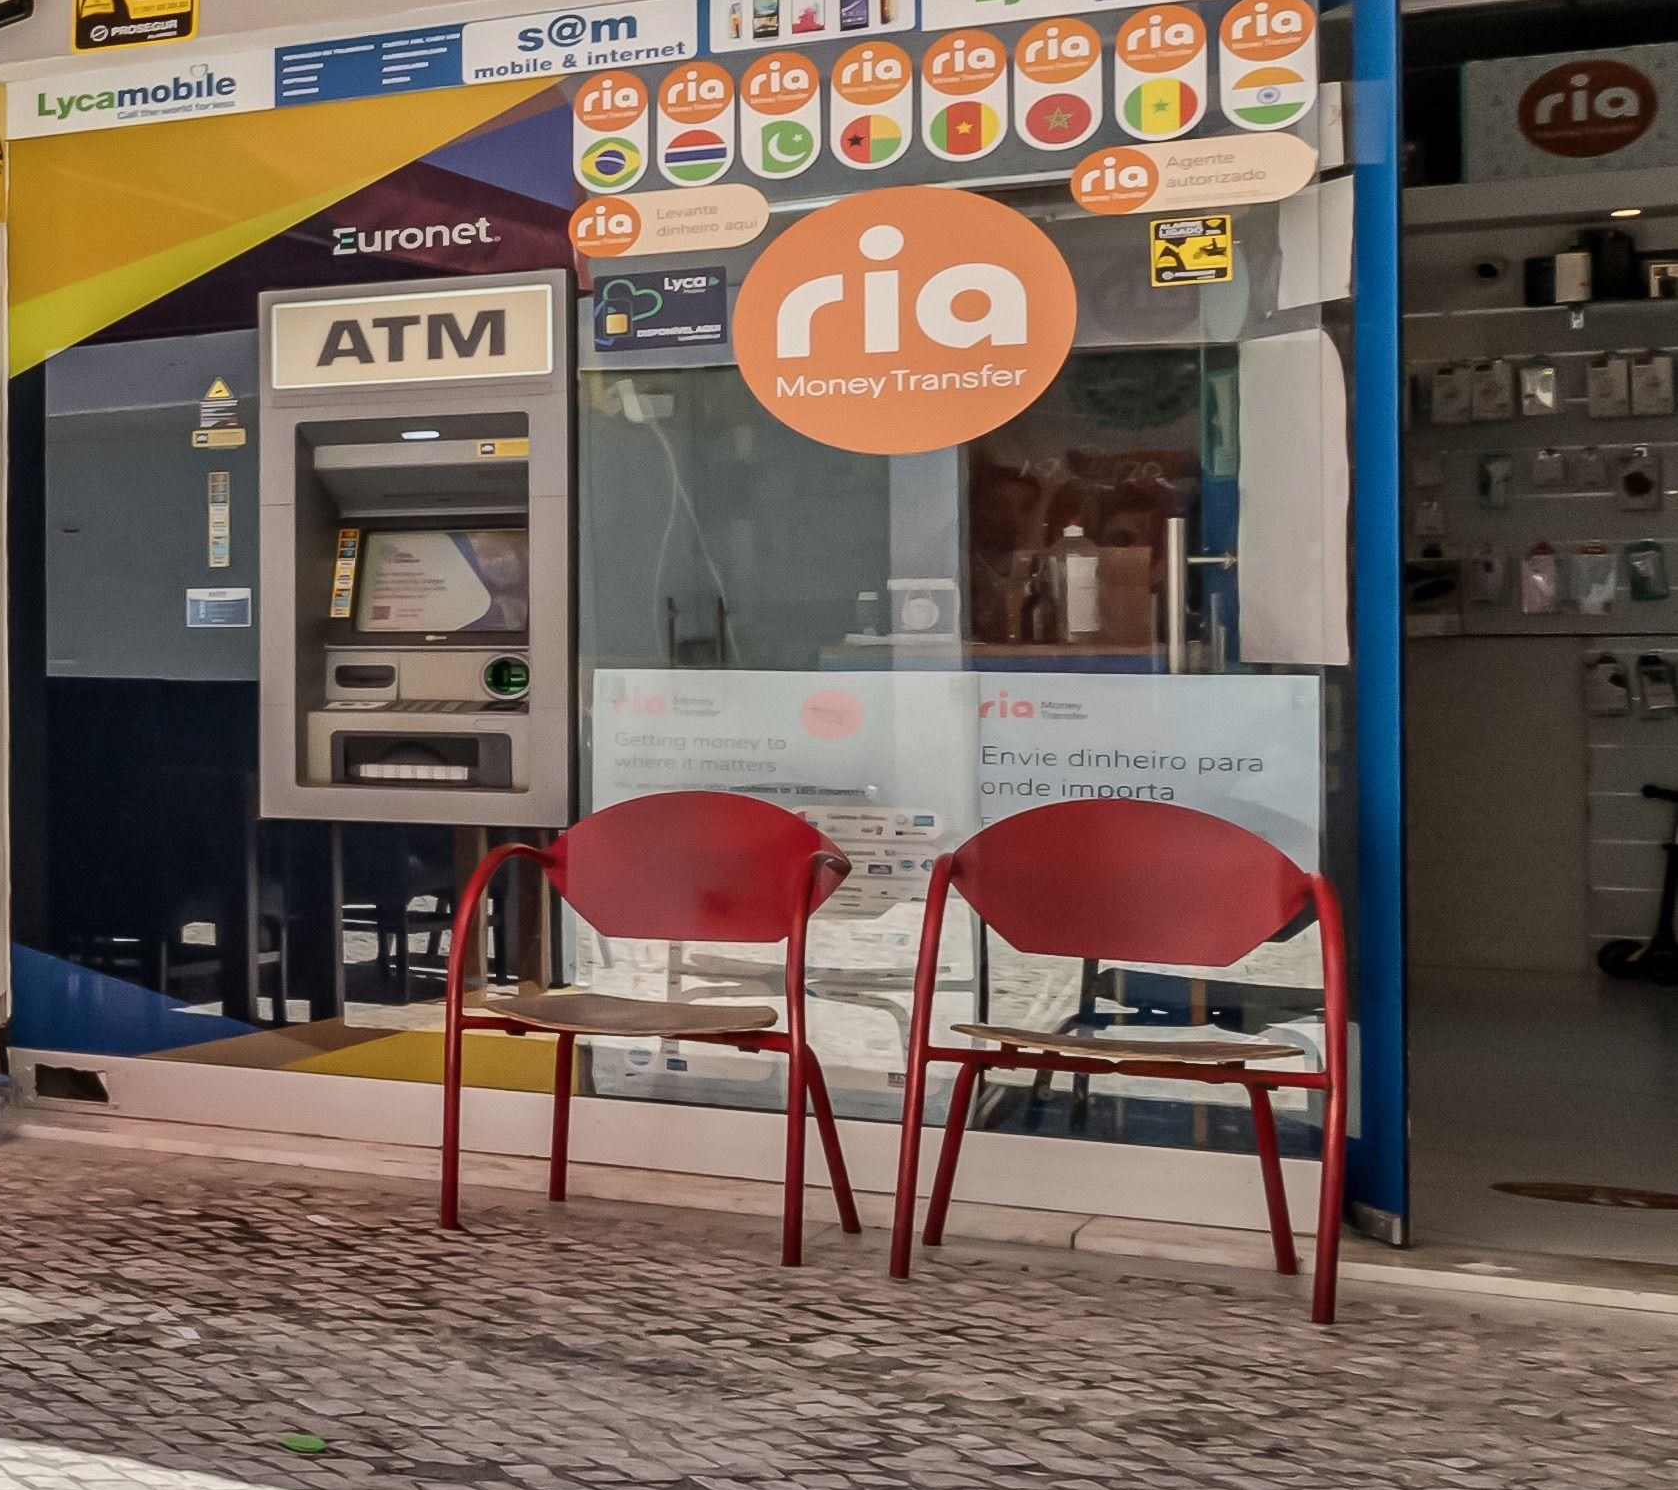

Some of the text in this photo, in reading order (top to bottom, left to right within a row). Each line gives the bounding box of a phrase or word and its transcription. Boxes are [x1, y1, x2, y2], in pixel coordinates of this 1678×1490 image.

[110, 20, 178, 37] PROSEGUR
[517, 12, 639, 54] s@m
[1126, 14, 1195, 51] ria
[1231, 1, 1303, 40] ria
[474, 56, 553, 80] mobile
[562, 53, 577, 69] &
[587, 40, 686, 66] internet
[932, 39, 997, 75] ria
[1025, 26, 1091, 63] ria
[750, 60, 809, 96] ria
[841, 50, 902, 85] ria
[37, 73, 237, 121] Lycamobile
[583, 78, 639, 112] ria
[668, 70, 725, 104] ria
[1534, 73, 1640, 126] ria
[1081, 156, 1149, 193] ria
[1165, 152, 1235, 170] Agente
[1166, 168, 1267, 188] autorizado
[577, 205, 633, 238] ria
[656, 204, 718, 219] Levante
[656, 219, 758, 237] dinheiro aqui
[332, 216, 496, 256] Euronet
[663, 276, 707, 292] Lyca
[776, 224, 1028, 359] ria
[315, 308, 507, 368] ATM
[776, 363, 1028, 399] Money Transfer
[979, 690, 1083, 719] ria Money
[614, 730, 787, 752] Getting money to
[614, 756, 777, 773] where it matters
[981, 745, 1264, 775] Envie dinheiro para
[980, 777, 1175, 802] onde importa
